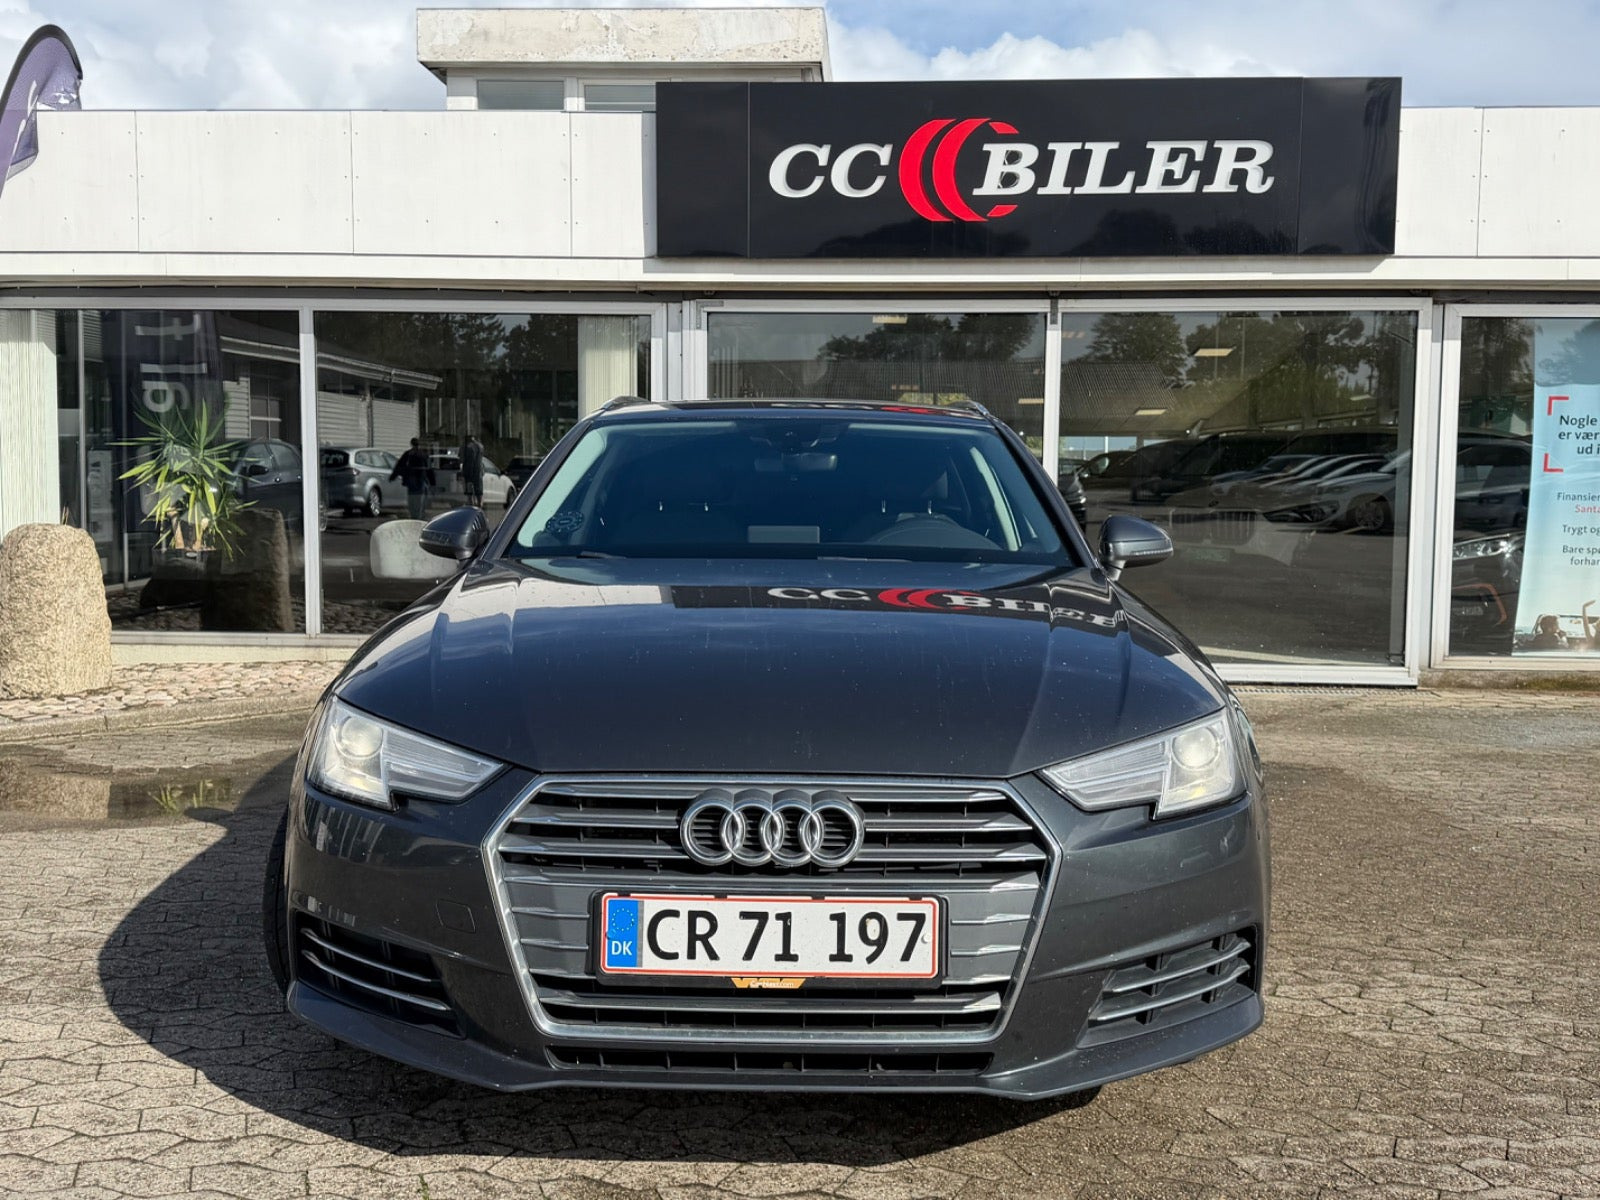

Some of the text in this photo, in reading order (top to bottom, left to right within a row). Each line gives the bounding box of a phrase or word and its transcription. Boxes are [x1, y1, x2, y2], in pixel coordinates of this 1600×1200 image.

[769, 139, 1275, 198] CC BILER
[1559, 414, 1598, 429] Nogle
[1558, 431, 1572, 440] er
[1577, 443, 1593, 455] ud
[1562, 524, 1587, 536] Trygt
[1562, 545, 1584, 554] Bare
[646, 909, 927, 964] CR 71 197
[611, 940, 632, 956] DK
